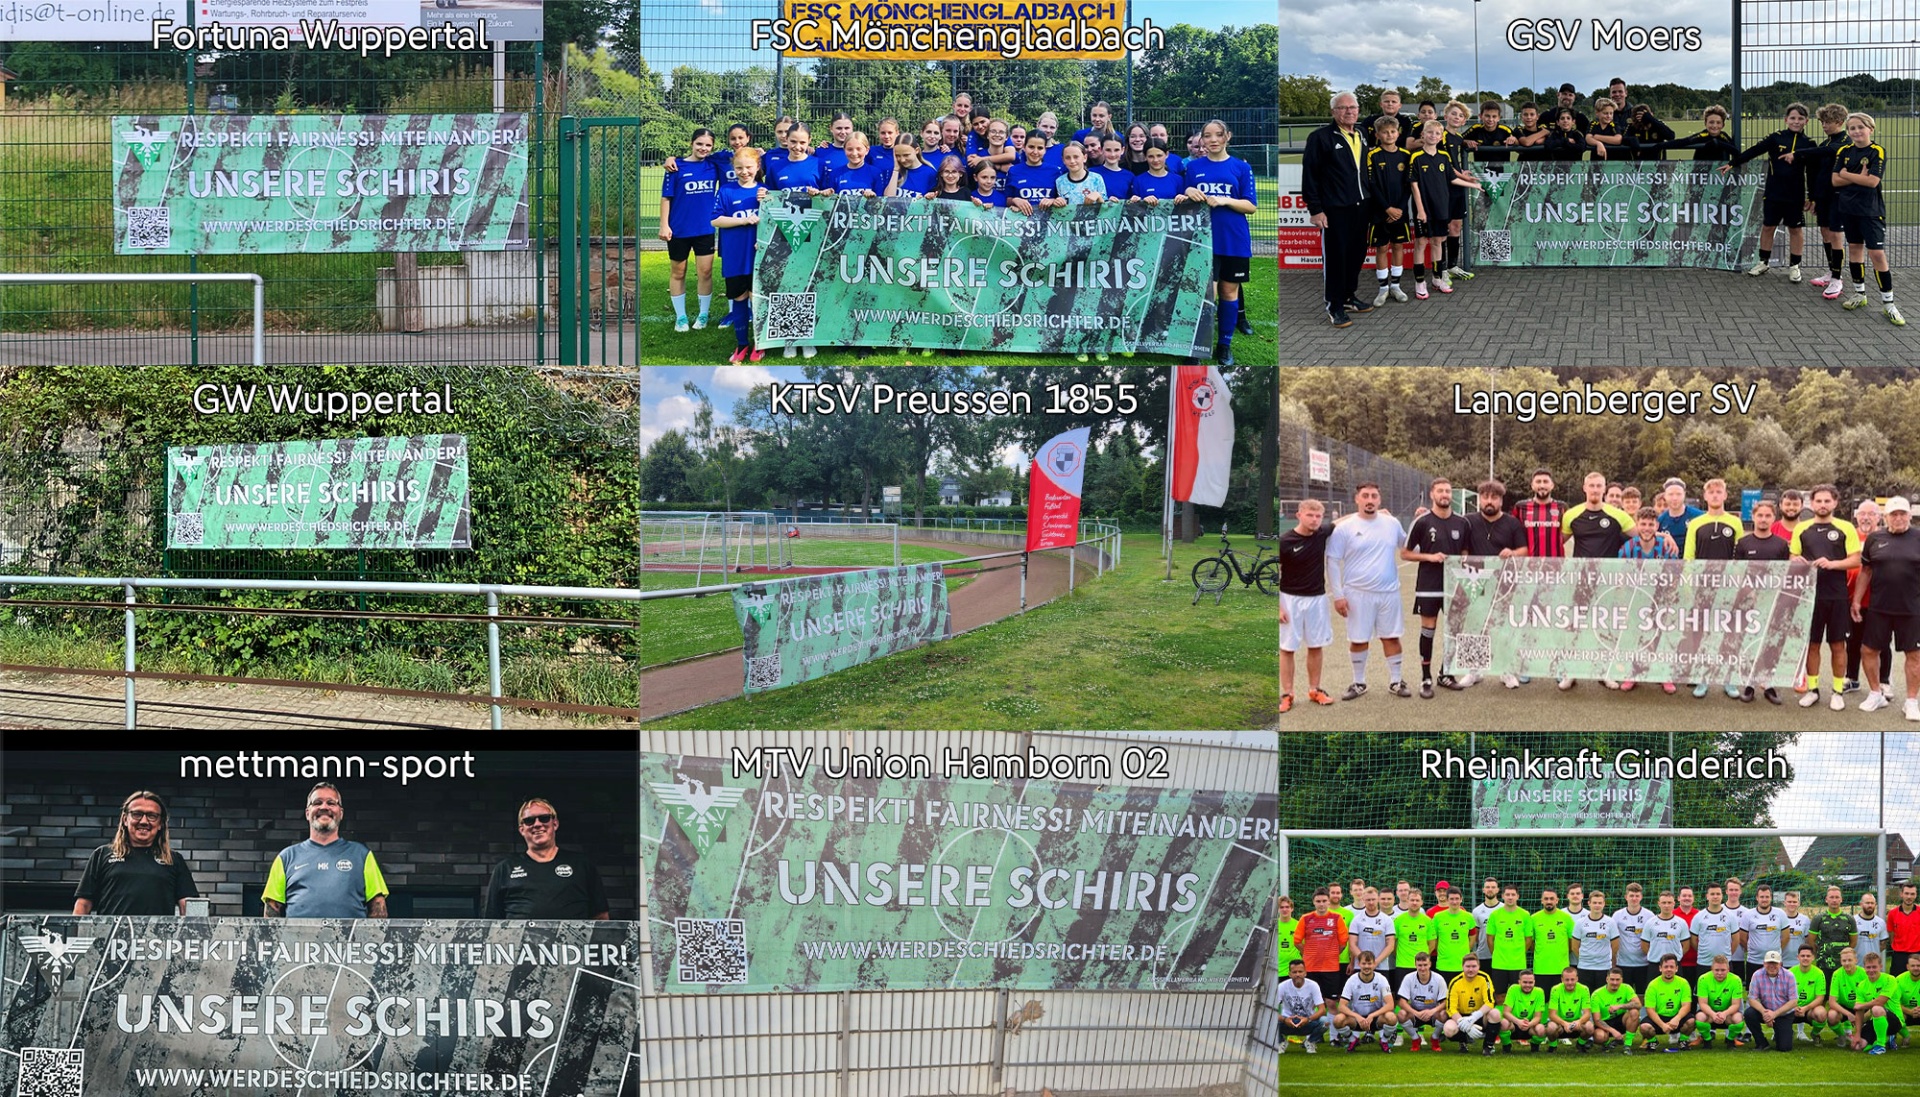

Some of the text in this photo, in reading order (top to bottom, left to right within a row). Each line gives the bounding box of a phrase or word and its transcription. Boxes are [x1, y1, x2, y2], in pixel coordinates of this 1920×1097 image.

[251, 9, 290, 17] Rohrbruch-
[292, 9, 305, 17] und
[306, 9, 367, 18] Reparaturservice
[791, 0, 1115, 20] FSC MÖNCHENGLADBACH
[181, 129, 521, 148] RESPEKT! FAIRNESS! MITEINANDER!
[188, 168, 471, 198] UNSERE SCHIRIS
[685, 180, 714, 191] OKI
[1197, 182, 1233, 195] OKI
[1520, 173, 1588, 185] RESPEKT!
[1593, 172, 1667, 185] FAIRNESS!
[1020, 187, 1052, 198] OKI
[203, 218, 456, 233] WWW.WERDESCHIEDSRICHTER.DE
[834, 211, 1202, 238] RESPEKT! FAIRNESS! MITEINANDER!
[1525, 202, 1744, 226] UNSERE SCHIRIS
[1536, 240, 1732, 253] WWW.WERDESCHIEDSRICHTER.DE
[839, 254, 1148, 290] UNSERE SCHIRIS
[853, 308, 1131, 331] WWW.WERDESCHIEDSRICHTER.DE
[211, 446, 461, 468] RESPEKT! FAIRNESS! MITEINANDER!
[215, 479, 421, 506] UNSERE SCHIRIS
[225, 521, 410, 532] WWW.WERDESCHIEDSRICHTER.DE
[1503, 570, 1810, 590] RESPEKT! FAIRNESS! MITEINANDER!
[790, 596, 928, 642] UNSERE SCHIRIS
[1508, 604, 1762, 634] UNSERE SCHIRIS
[1507, 788, 1643, 803] UNSERE SCHIRIS
[763, 790, 1279, 841] RESPEKT! FAIRNESS! MITEINANDER!
[777, 858, 1201, 914] UNSERE SCHIRIS
[110, 938, 628, 967] RESPEKT! FAIRNESS! MITEINANDER!
[802, 939, 1169, 962] WWW.WERDESCHIEDSRICHTER.DE
[116, 993, 555, 1039] UNSERE SCHIRIS
[135, 1067, 533, 1092] WWW.WERDESCHIEDSRICHTER.DE
